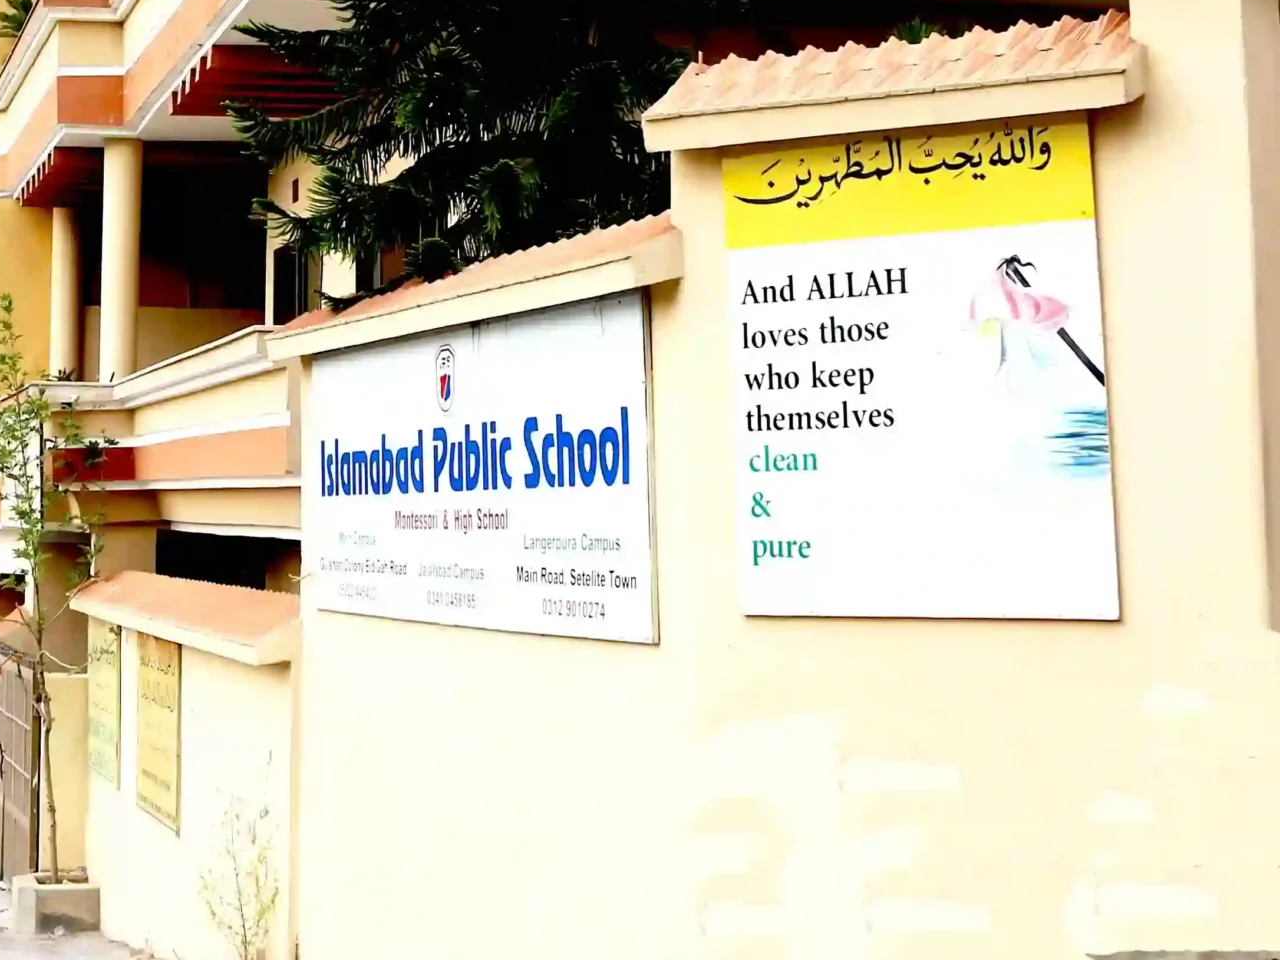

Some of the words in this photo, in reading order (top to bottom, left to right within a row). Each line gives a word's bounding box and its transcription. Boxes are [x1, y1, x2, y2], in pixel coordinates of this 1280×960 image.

[741, 274, 795, 306] And
[807, 267, 909, 301] ALLAH
[741, 321, 809, 349] loves
[819, 315, 890, 346] those
[744, 365, 800, 391] who
[811, 360, 875, 395] keep
[745, 400, 896, 433] themselves
[321, 429, 424, 497] Islamabad
[433, 421, 513, 493] Public
[523, 406, 630, 489] School
[749, 445, 819, 473] clean
[750, 490, 772, 519] &
[395, 510, 439, 530] Montessori
[442, 510, 449, 529] &
[454, 509, 473, 535] High
[477, 508, 508, 530] School
[581, 533, 621, 556] Campus
[752, 537, 812, 567] pure
[390, 560, 408, 575] Road
[453, 564, 484, 583] Campus
[516, 565, 538, 583] Main
[570, 568, 606, 587] Setelite
[609, 570, 637, 589] Town
[542, 598, 563, 616] 0312
[566, 600, 605, 620] 9010274
